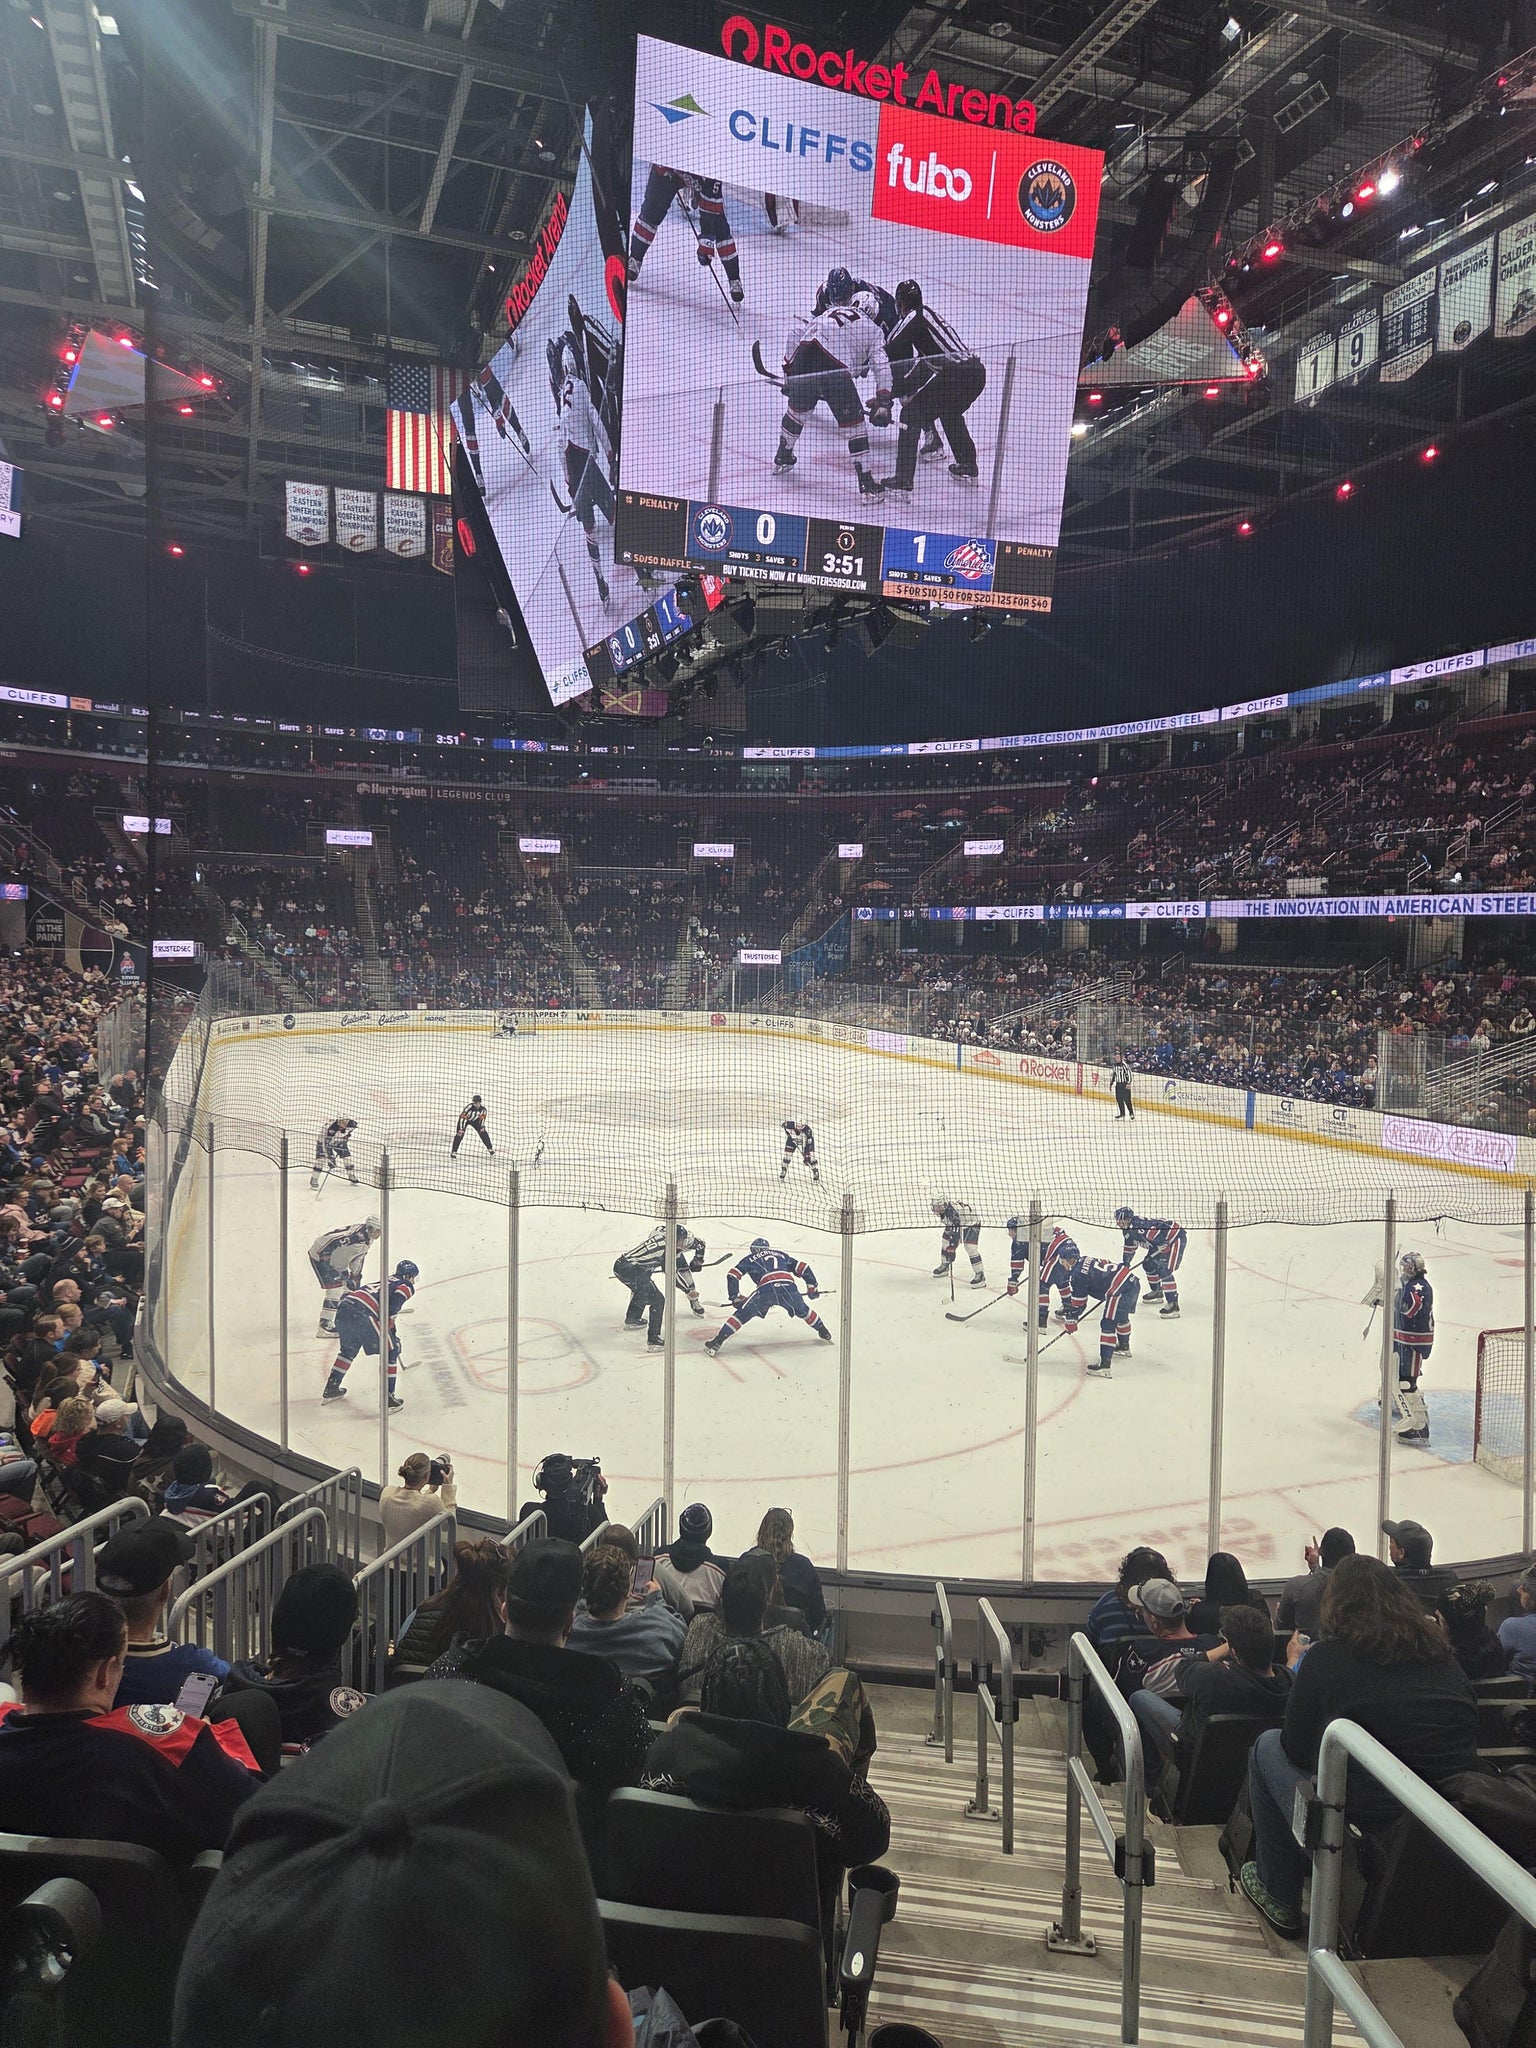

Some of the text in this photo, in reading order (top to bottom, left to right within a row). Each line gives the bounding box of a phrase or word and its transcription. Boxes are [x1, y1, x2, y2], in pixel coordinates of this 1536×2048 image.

[764, 24, 1036, 133] Rocket Arena
[729, 110, 873, 172] CLIFFS
[887, 143, 972, 202] fubo
[1028, 163, 1071, 187] CLEVELAND
[1025, 208, 1064, 230] MONSTERS
[512, 191, 567, 317] Rocket Arena
[1501, 240, 1533, 267] CALDER
[1443, 256, 1489, 288] CHAMPIONS
[1384, 271, 1434, 304] CLEVELAND
[1341, 308, 1377, 334] GLOVER
[1351, 332, 1364, 368] 9
[1310, 354, 1319, 390] 1
[293, 486, 323, 497] 2006-07
[293, 497, 322, 507] EASTERN
[342, 504, 370, 514] EASTERN
[639, 496, 679, 511] PENALTY
[288, 506, 327, 517] CONFERENCE
[337, 512, 375, 523] CONFERENCE
[391, 509, 418, 519] EASTERN
[698, 507, 730, 524] CLEVELAND
[290, 515, 327, 525] CHAMPIONS
[339, 521, 374, 531] CHAMPIONS
[386, 518, 424, 529] CONFERENCE
[387, 526, 422, 537] CHAMPIONS
[756, 513, 776, 545] 0
[843, 537, 848, 545] 1
[913, 535, 926, 564] 1
[1017, 546, 1053, 559] PENALTY
[633, 553, 691, 569] 50/50 RAFFLE
[728, 551, 797, 567] SHOTS 3 SAVES 2
[823, 552, 863, 576] 3:51
[723, 564, 867, 591] BUY TICKETS NOW AT MONSTERS5050.COM
[888, 570, 953, 584] SHOTS 3 SAVES 3
[897, 585, 1048, 609] 5 FOR $10 50 FOR $20 125 FOR $40
[662, 599, 672, 623] 1
[625, 625, 635, 648] 0
[647, 633, 661, 650] 3:51
[1424, 655, 1474, 674] CLIFFS
[563, 666, 588, 687] CLIFFS
[7, 690, 57, 704] CLIFFS
[1247, 697, 1284, 712] CLIFFS
[279, 724, 356, 737] SHOTS 3 SAVES 2
[396, 730, 404, 741] 0
[999, 713, 1204, 747] THE PRECISION IN AUTOMOTIVE STEEL
[436, 735, 460, 746] 3:51
[510, 739, 516, 749] 1
[935, 741, 973, 752] CLIFFS
[573, 745, 580, 753] 3
[612, 746, 619, 754] 3
[772, 748, 811, 757] CLIFFS
[437, 789, 482, 801] LEGENDS
[485, 792, 511, 802] CLUB
[344, 834, 371, 842] CLIFFS
[708, 846, 732, 854] CLIFFS
[1003, 908, 1035, 918] CLIFFS
[1157, 904, 1200, 917] CLIFFS
[1246, 902, 1269, 915] THE
[1273, 901, 1359, 915] INNOVATION
[1365, 900, 1379, 914] IN
[1385, 897, 1474, 914] AMERICAN
[889, 910, 895, 918] 0
[903, 909, 914, 918] 3:51
[936, 909, 941, 918] 1
[36, 924, 63, 933] IN THE
[36, 933, 63, 942] PAINT
[154, 944, 192, 953] TRUSTEDSEC
[824, 942, 848, 952] Full Court
[828, 951, 844, 960] Power
[765, 1018, 794, 1028] CLIFFS
[1030, 1058, 1070, 1081] Rocket
[764, 1255, 778, 1269] 7
[1398, 1394, 1413, 1418] CCM
